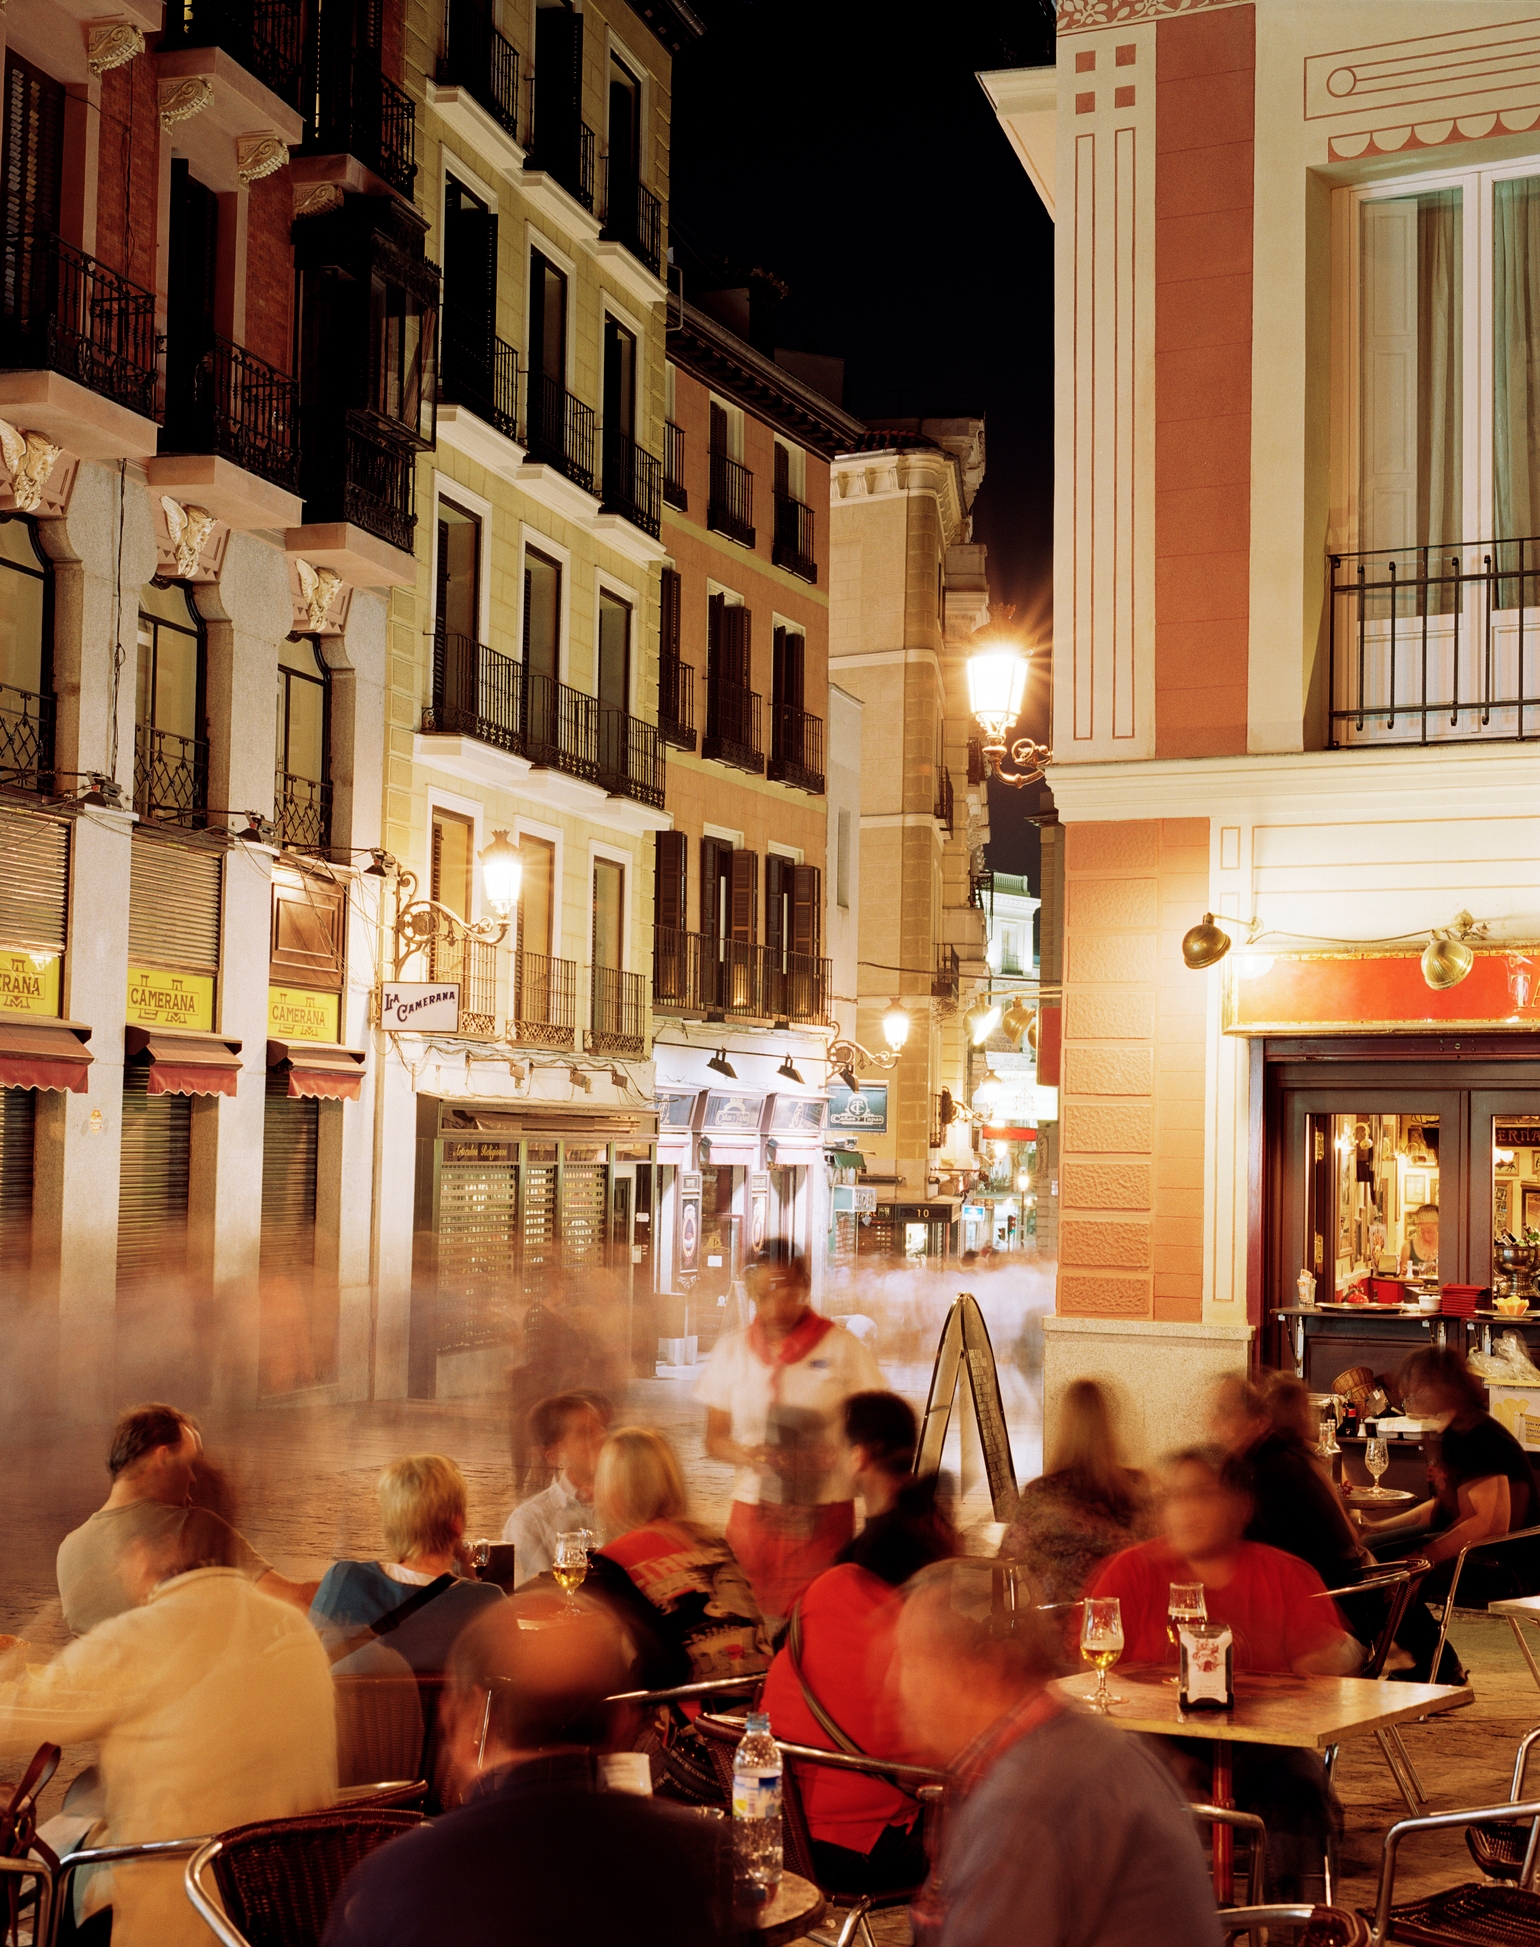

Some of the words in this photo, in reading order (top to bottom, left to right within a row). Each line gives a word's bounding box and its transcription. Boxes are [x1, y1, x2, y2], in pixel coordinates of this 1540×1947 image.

[0, 973, 41, 996] RANA
[131, 987, 195, 1013] CAMERANA
[397, 991, 455, 1022] CAMERANA
[272, 1005, 325, 1027] CAMERANA
[917, 1209, 929, 1218] 10
